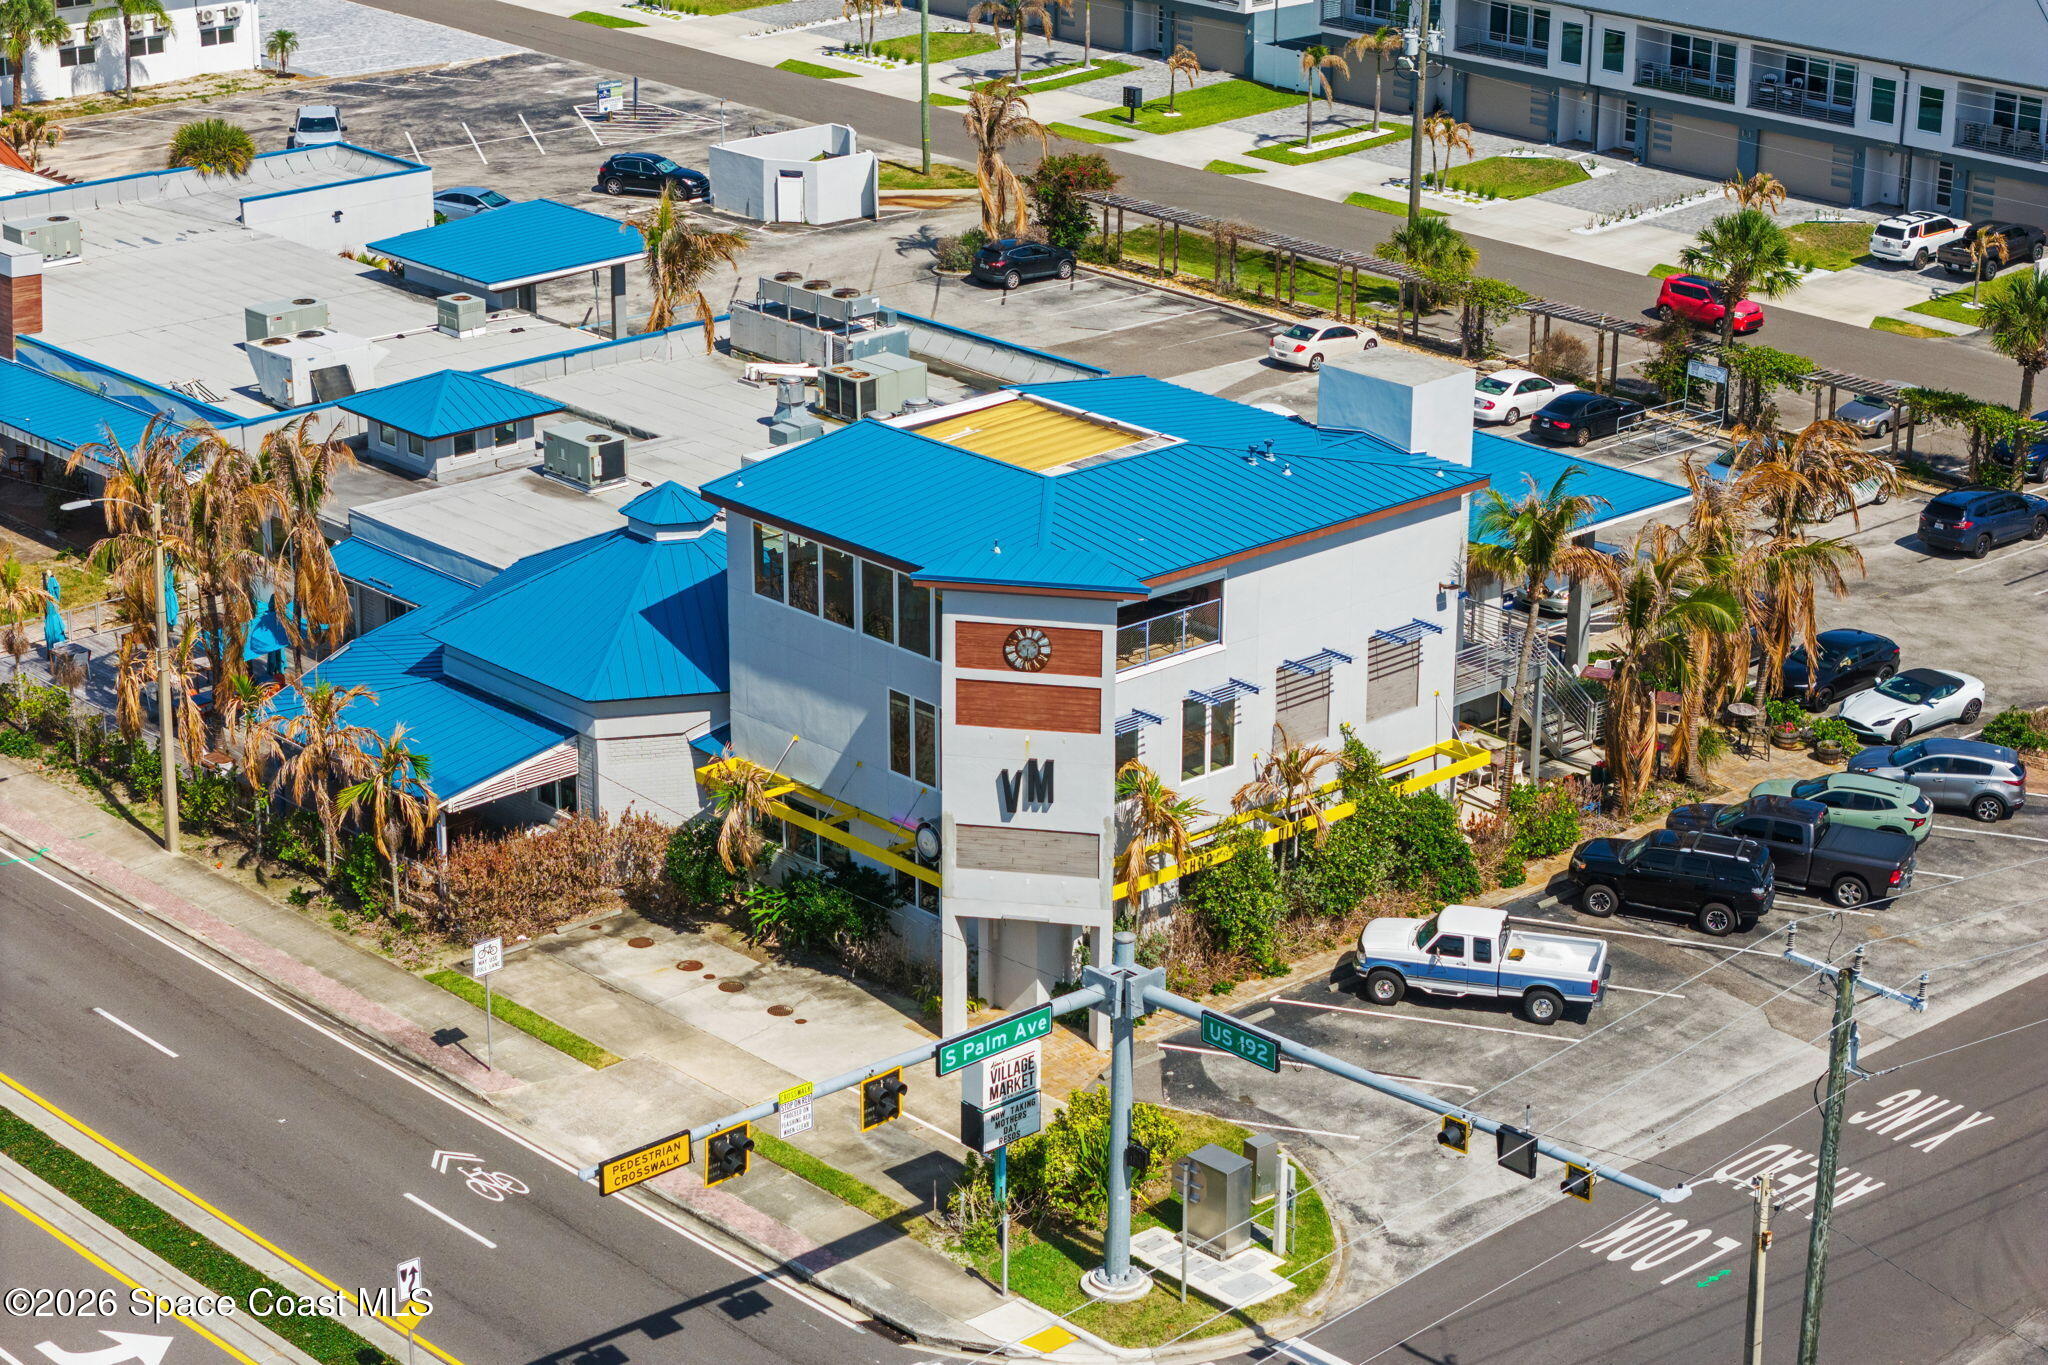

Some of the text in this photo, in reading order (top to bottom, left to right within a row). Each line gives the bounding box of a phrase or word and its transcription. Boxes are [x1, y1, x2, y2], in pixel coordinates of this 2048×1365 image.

[1001, 758, 1054, 813] VM
[1279, 819, 1306, 840] DINE
[945, 1017, 1047, 1067] S Palm Ave
[1209, 1022, 1268, 1063] US 192
[990, 1055, 1035, 1084] VILLAGE
[780, 1086, 811, 1101] CROSSWALK
[989, 1070, 1035, 1101] MARKET
[781, 1094, 812, 1112] STOP ON RED
[991, 1098, 1036, 1123] NOW TAKING
[995, 1110, 1027, 1129] MOTHERS
[1003, 1123, 1018, 1135] DAY
[1847, 1089, 1995, 1153] XING
[999, 1130, 1021, 1144] RESOS
[612, 1141, 681, 1174] PEDESTRIAN
[614, 1154, 680, 1186] CROSSWALK
[1712, 1143, 1886, 1220] AHEAD
[1579, 1207, 1743, 1285] LOOK
